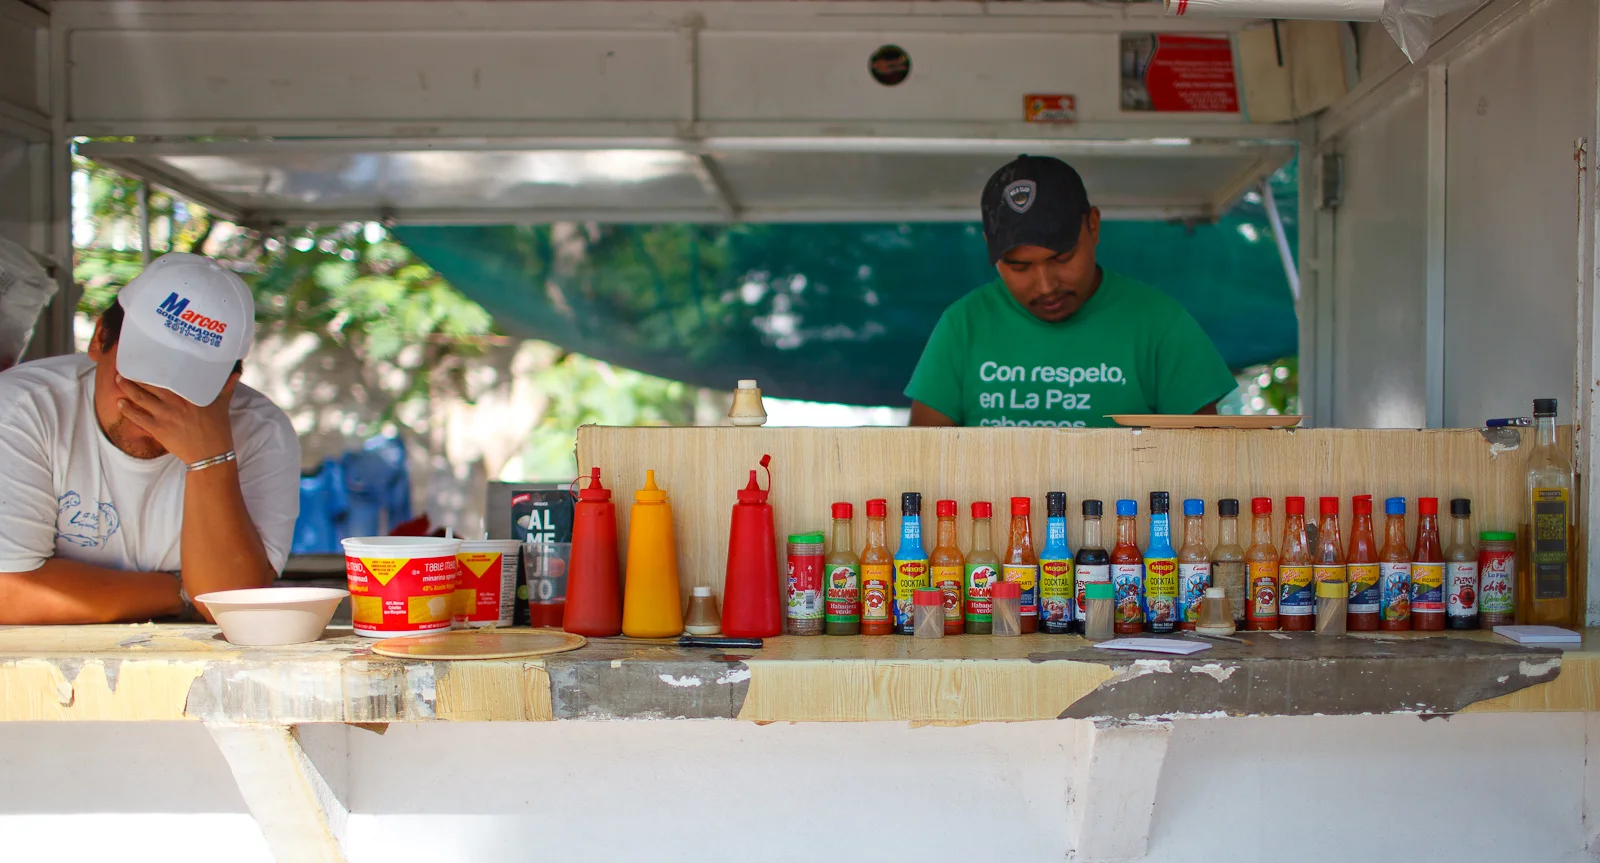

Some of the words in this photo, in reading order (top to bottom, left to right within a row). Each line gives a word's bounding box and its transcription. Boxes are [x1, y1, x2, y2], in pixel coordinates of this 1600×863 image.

[159, 291, 227, 334] Marcos
[156, 308, 223, 341] GOBERNADOR
[979, 361, 1025, 382] Con
[1031, 362, 1126, 388] respeto,
[979, 392, 1004, 409] en
[1010, 388, 1040, 409] La
[1045, 389, 1091, 410] Paz
[527, 509, 556, 530] AL
[527, 532, 556, 552] ME
[527, 579, 552, 600] TO
[900, 578, 926, 587] COCKTAIL
[1043, 577, 1069, 586] COCKTAIL
[1149, 577, 1175, 586] COCKTAIL
